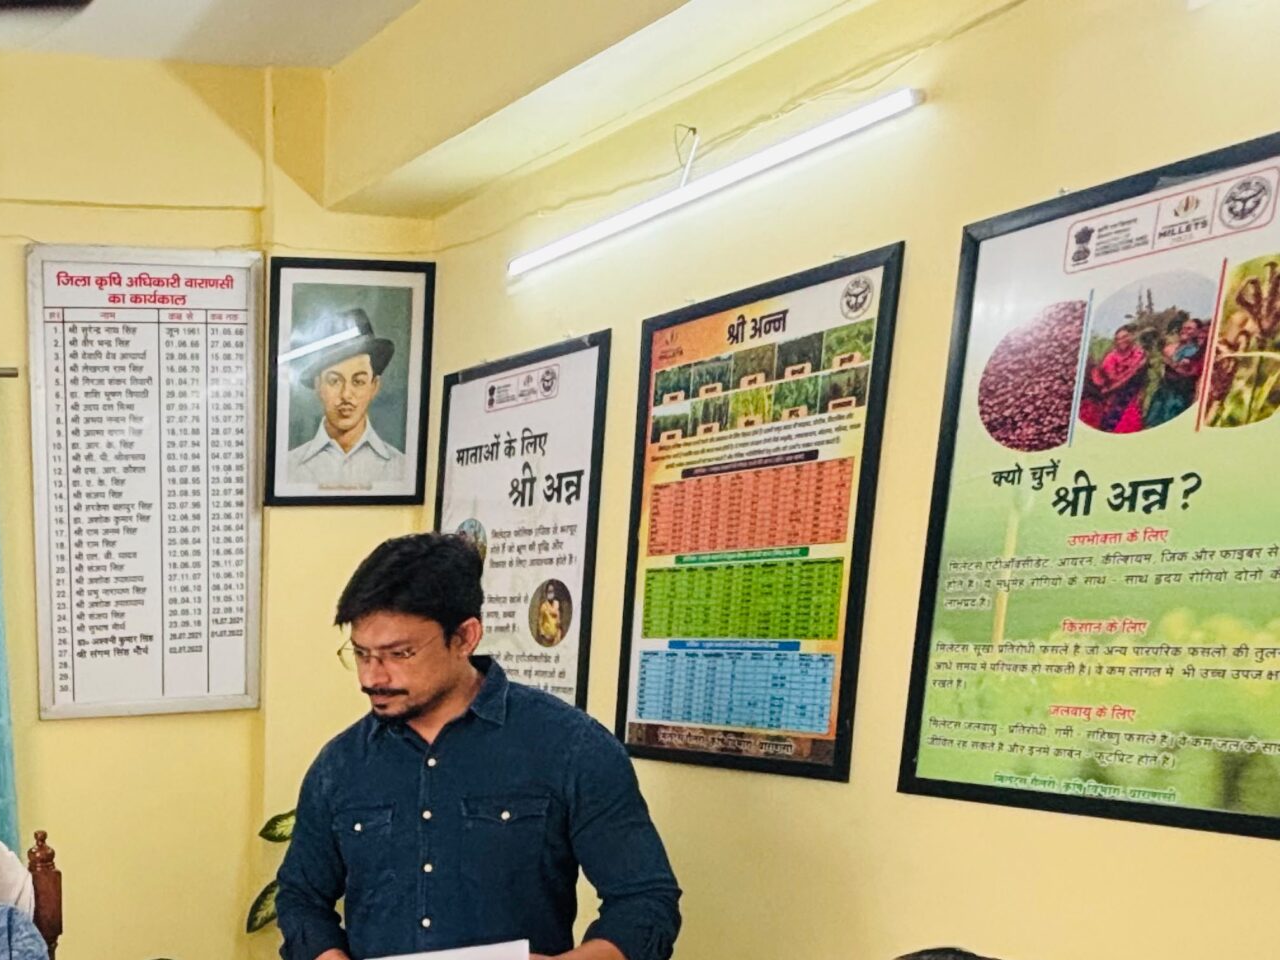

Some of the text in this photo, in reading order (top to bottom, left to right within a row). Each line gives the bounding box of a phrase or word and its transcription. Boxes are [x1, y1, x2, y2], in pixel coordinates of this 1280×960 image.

[56, 271, 234, 290] जिला कृषि अधिकारी वाराणसी
[108, 290, 187, 305] का कार्यकाल
[726, 308, 789, 345] श्री अन्न
[456, 428, 548, 467] माताओं के लिए
[509, 462, 584, 508] श्री अन्न
[1051, 469, 1096, 517] श्री
[1067, 526, 1169, 546] उपभोक्ता के लिए
[1062, 617, 1148, 634] किसान के लिए
[1232, 642, 1250, 658] की
[1106, 665, 1126, 676] कम
[1129, 665, 1162, 677] लागत
[1182, 664, 1196, 678] भी
[1231, 668, 1263, 681] उपज
[1049, 704, 1137, 721] जलवायु के लिए
[1191, 738, 1214, 749] कम
[1216, 739, 1241, 753] जल
